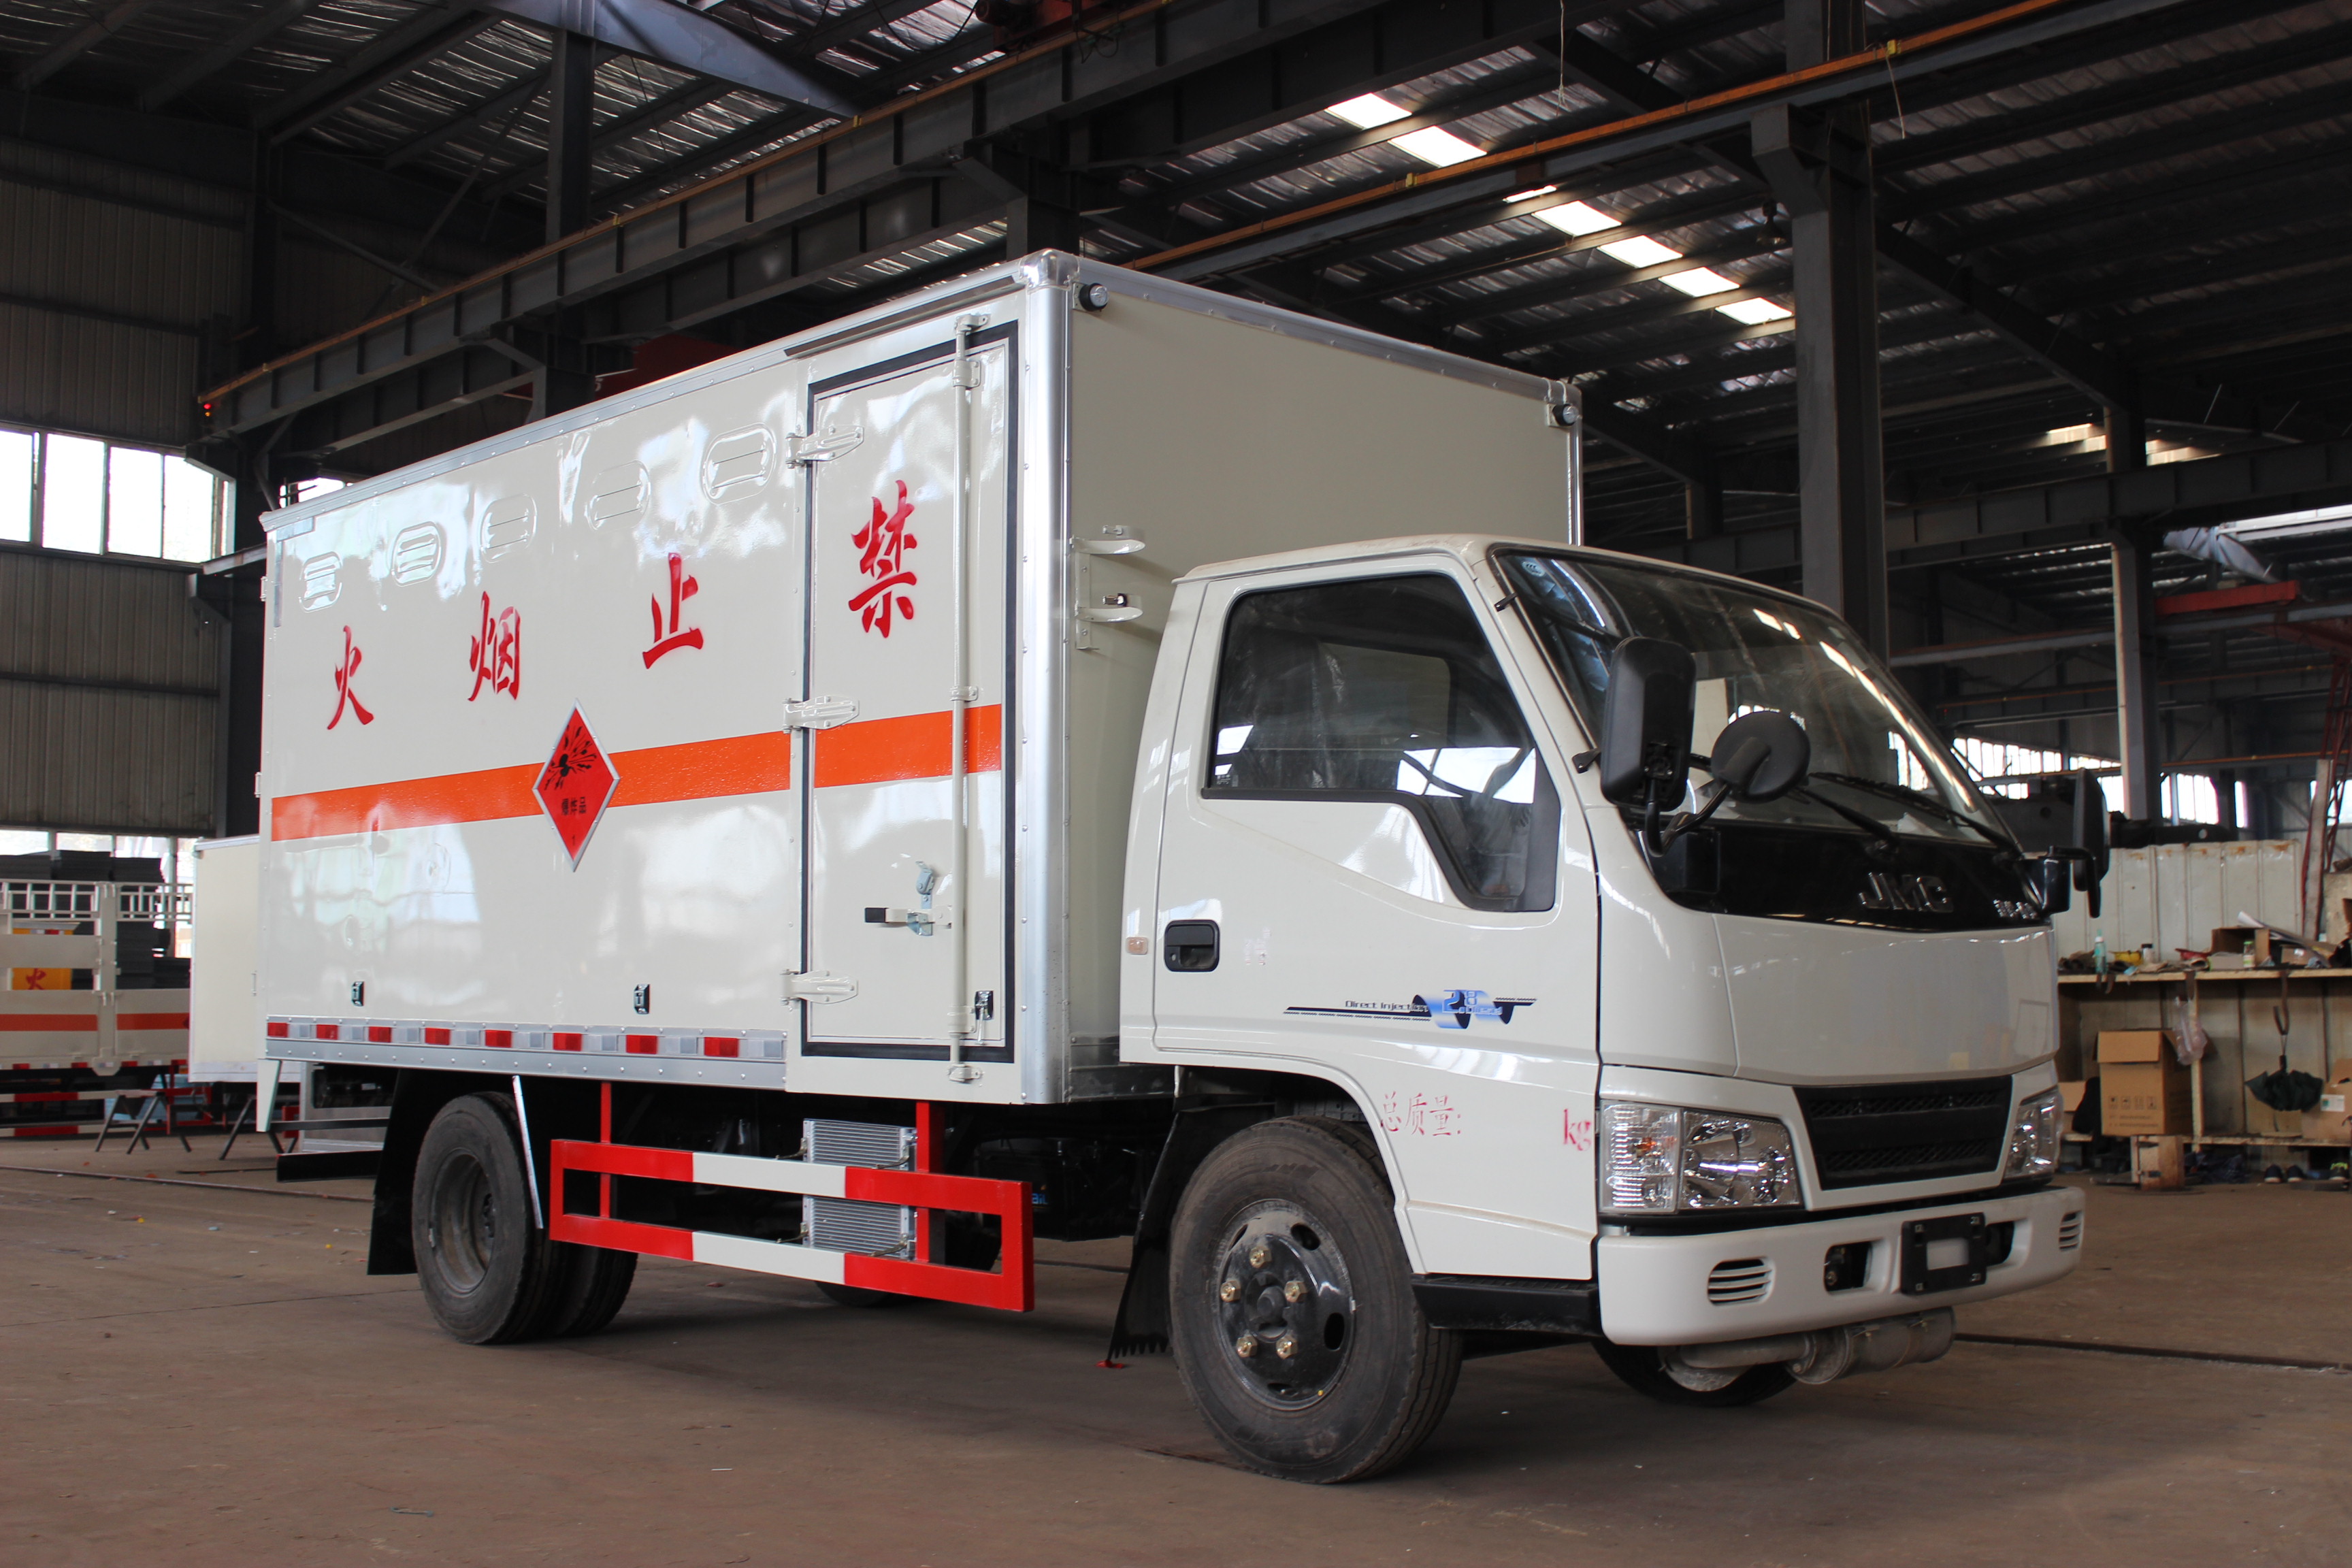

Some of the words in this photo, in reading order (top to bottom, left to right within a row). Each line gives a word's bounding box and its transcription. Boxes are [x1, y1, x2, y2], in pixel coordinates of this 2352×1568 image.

[849, 480, 918, 638] 禁
[468, 591, 521, 702] 烟
[642, 554, 705, 669] 止
[328, 626, 375, 730] 火
[1858, 872, 1954, 913] JMC
[1345, 1000, 1377, 1009] Direct
[1380, 1002, 1428, 1012] Injection
[1563, 1108, 1591, 1151] kg
